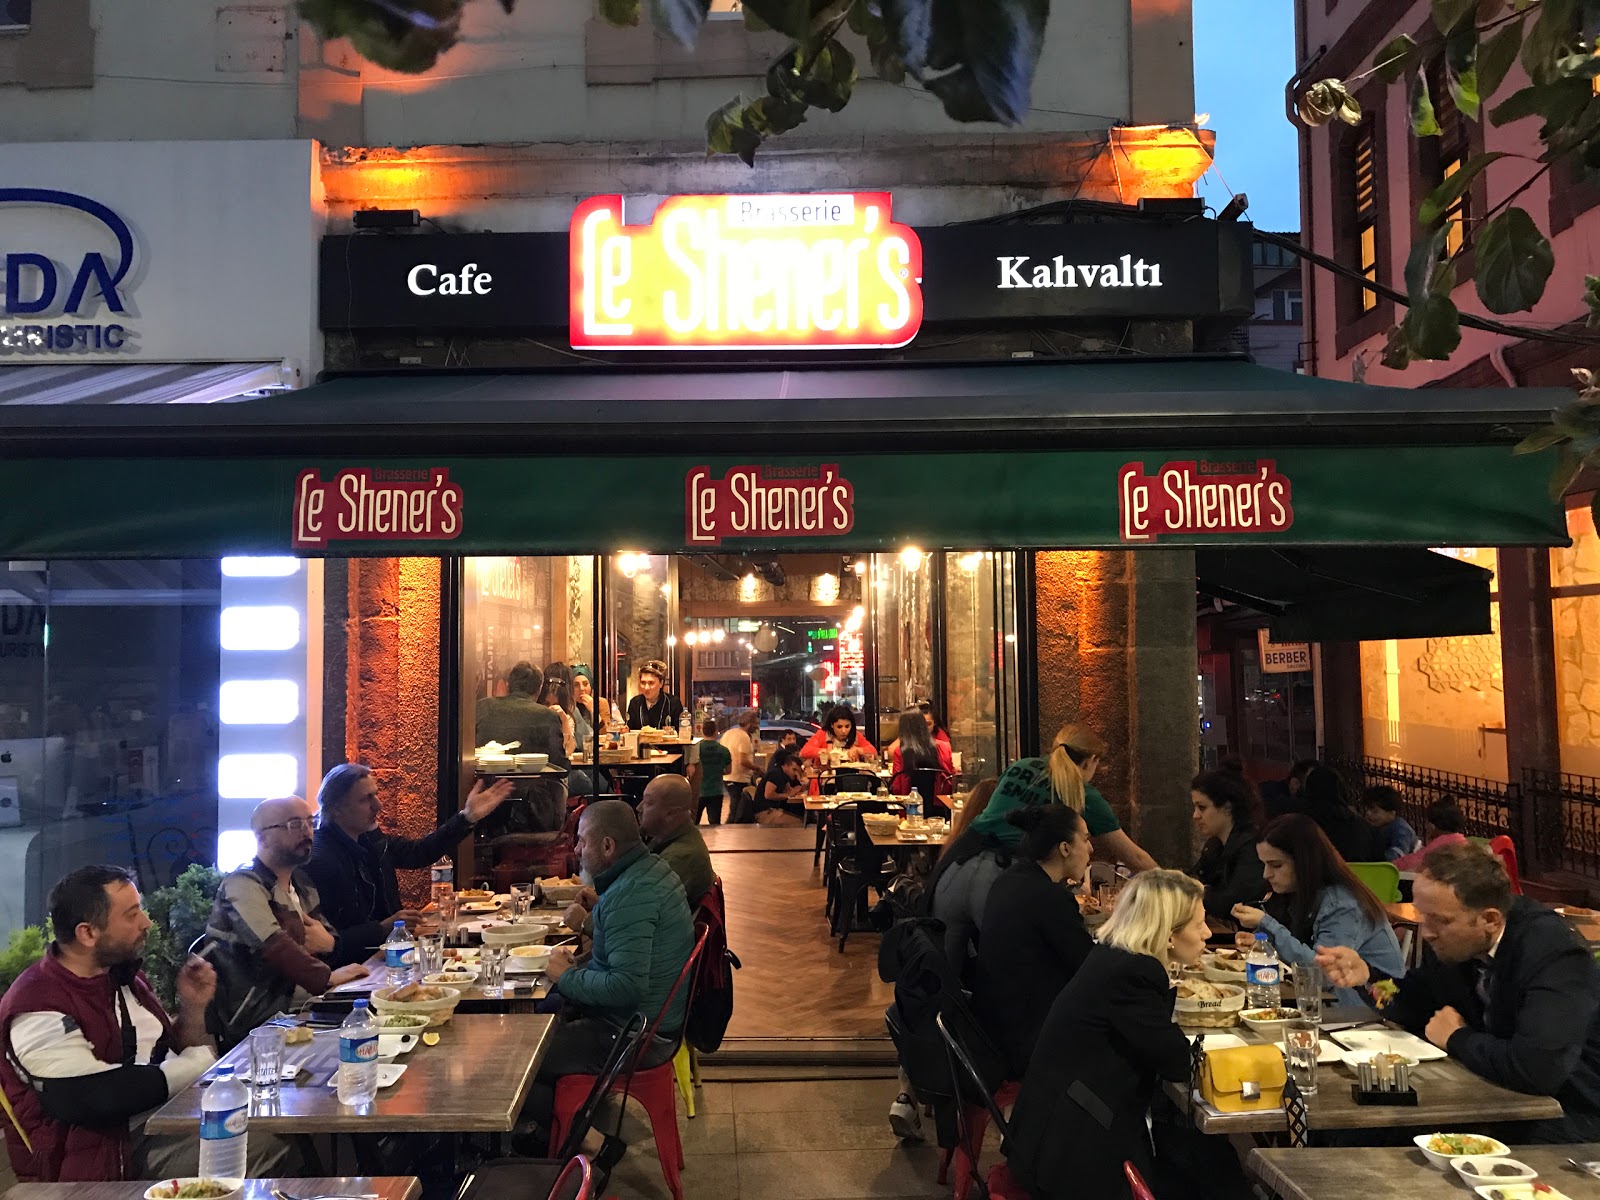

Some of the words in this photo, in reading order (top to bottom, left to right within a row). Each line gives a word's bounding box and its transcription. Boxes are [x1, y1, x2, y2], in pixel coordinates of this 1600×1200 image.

[407, 262, 493, 296] Cafe
[583, 208, 633, 336] Le
[662, 205, 911, 332] Shener's
[996, 253, 1164, 289] Kahvaltı
[374, 467, 429, 481] Brasserie
[764, 463, 818, 477] Brasserie
[1200, 459, 1254, 473] Brasserie
[297, 473, 325, 542] Le
[337, 473, 458, 534] Shener's
[691, 472, 717, 541] Le
[730, 471, 849, 531] Shener's
[1123, 470, 1150, 540] Le
[1162, 466, 1287, 529] Shener's
[1265, 650, 1307, 665] BERBER
[1197, 1000, 1222, 1009] Bread
